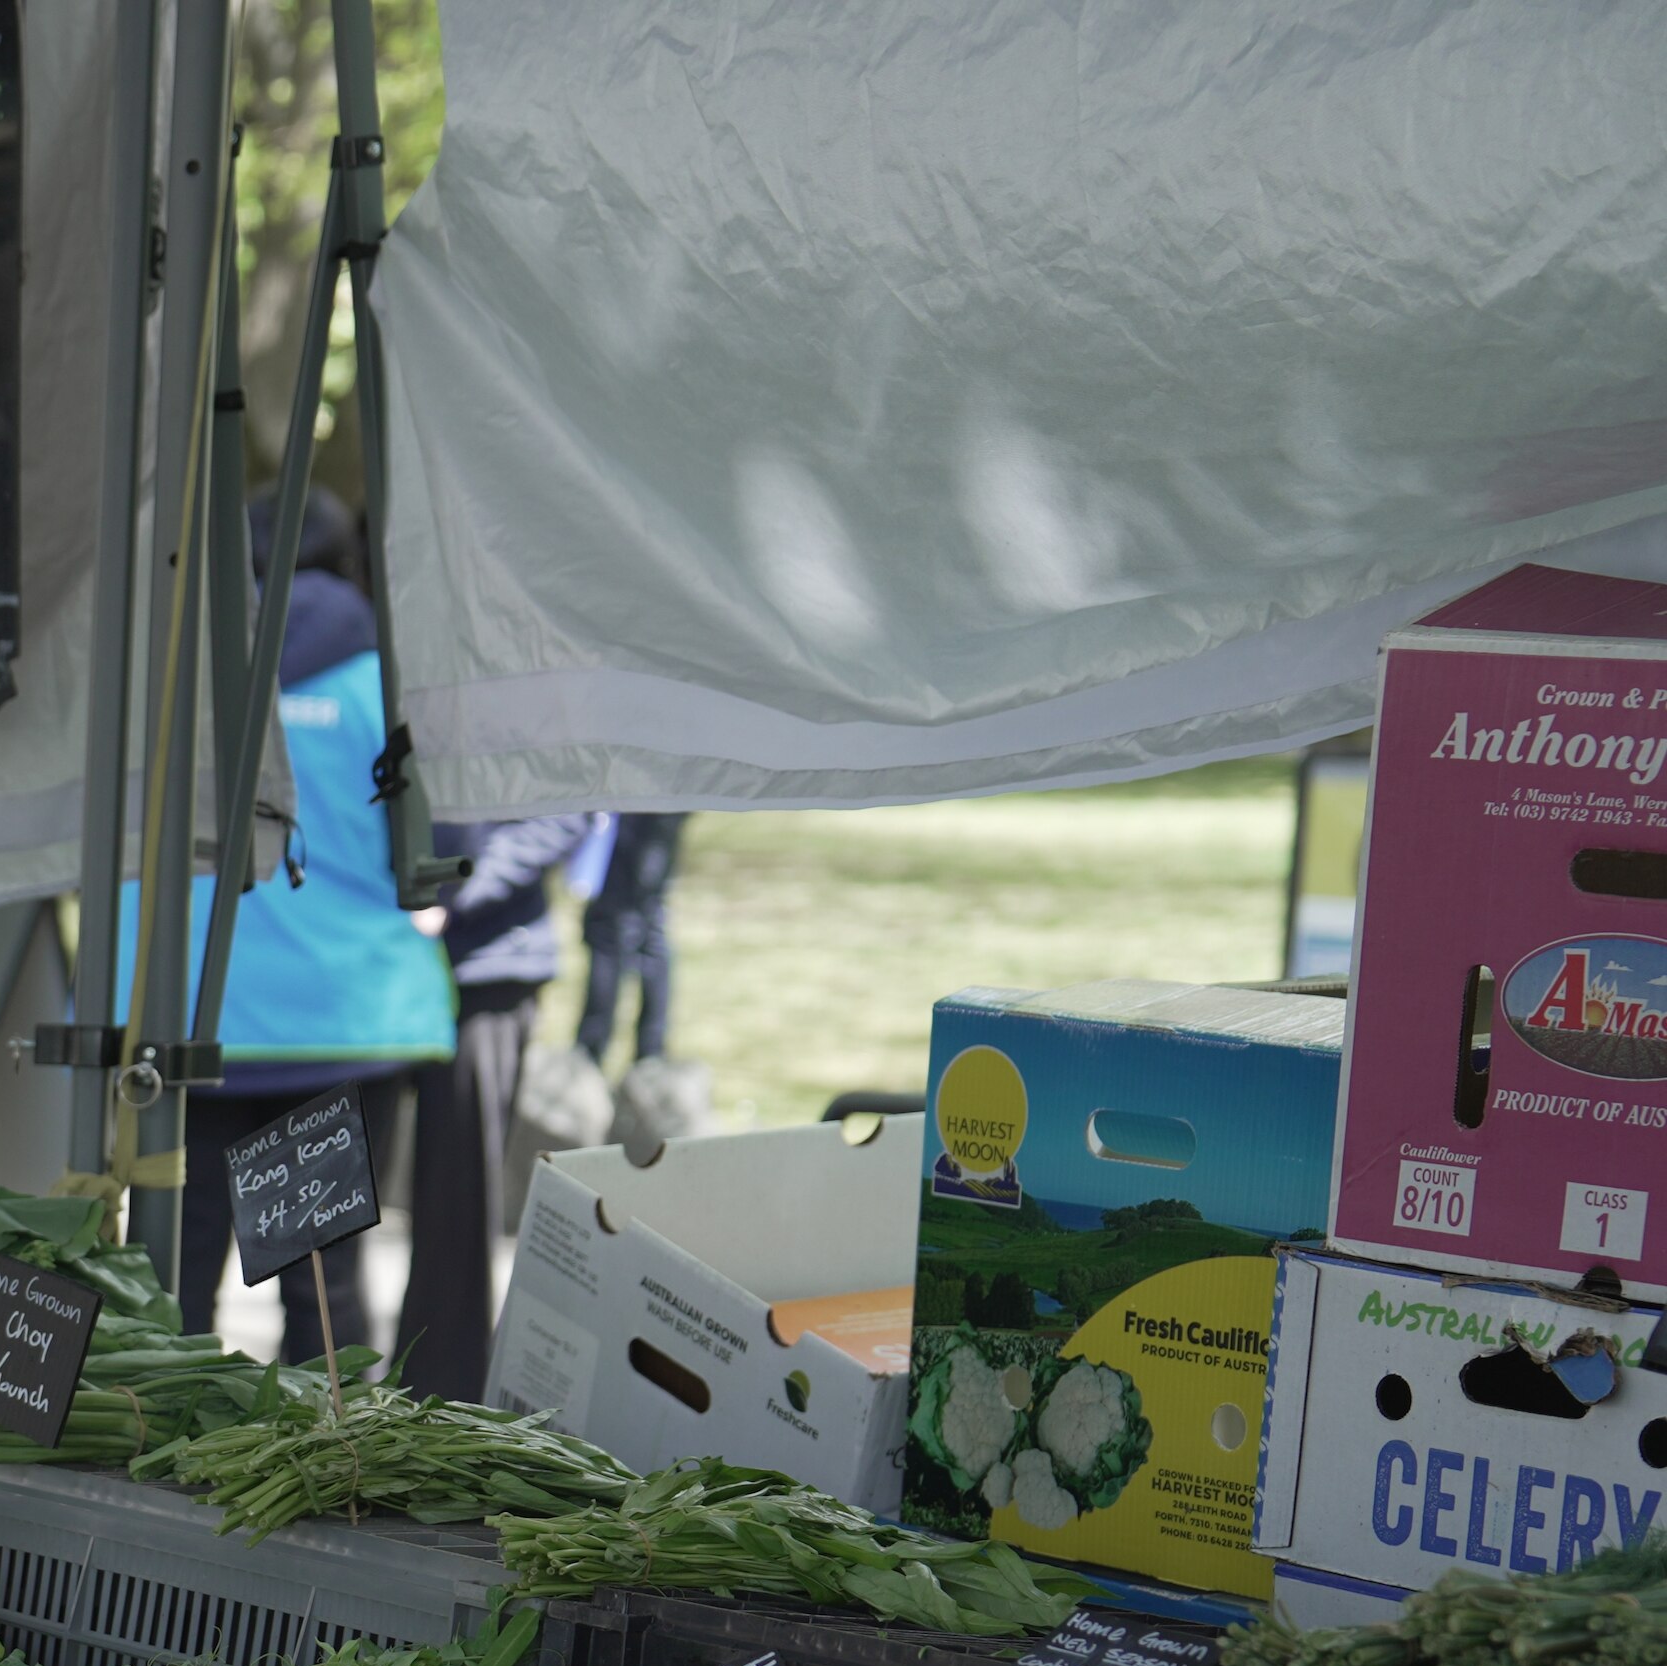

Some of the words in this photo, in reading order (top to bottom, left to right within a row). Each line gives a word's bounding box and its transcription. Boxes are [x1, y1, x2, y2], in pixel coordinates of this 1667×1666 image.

[1537, 683, 1616, 708] Grown
[1622, 687, 1644, 709] &
[1648, 689, 1667, 710] P
[1430, 711, 1667, 786] Anthony
[1483, 802, 1510, 818] Tel:
[1513, 804, 1546, 821] (03)
[1549, 806, 1589, 823] 9742
[1593, 809, 1633, 826] 1943
[1511, 788, 1521, 801] 4
[1524, 787, 1583, 807] Mason's
[1586, 792, 1627, 812] Lane,
[1526, 948, 1589, 1032] A
[1492, 1088, 1591, 1120] PRODUCT
[1592, 1100, 1624, 1123] OF
[226, 1129, 283, 1170] Home
[286, 1096, 351, 1137] Grown
[947, 1116, 1016, 1142] HARVEST
[235, 1163, 290, 1200] Kang
[297, 1127, 352, 1166] Kong
[952, 1139, 1006, 1163] MOON
[1400, 1142, 1482, 1166] Cauliflower
[1413, 1167, 1461, 1188] COUNT
[1400, 1185, 1465, 1228] 8/10
[1584, 1190, 1629, 1211] CLASS
[1595, 1212, 1610, 1249] 1
[25, 1275, 83, 1325] Grown
[640, 1275, 705, 1324] AUSTRALIAN
[704, 1316, 749, 1354] GROWN
[5, 1310, 54, 1364] Choy
[646, 1301, 675, 1327] WASH
[674, 1316, 713, 1352] BEFORE
[713, 1342, 734, 1366] USE
[1124, 1310, 1183, 1342] Fresh
[1141, 1343, 1201, 1364] PRODUCT
[1204, 1354, 1221, 1367] OF
[767, 1397, 819, 1441] Freshcare
[1152, 1477, 1221, 1502] HARVEST
[1158, 1468, 1194, 1483] GROWN
[1195, 1476, 1201, 1484] &
[1204, 1476, 1242, 1492] PACKED
[1190, 1504, 1218, 1515] LEITH
[1220, 1509, 1248, 1522] ROAD
[1372, 1439, 1663, 1577] CELERY
[1160, 1526, 1195, 1541] PHONE:
[1197, 1533, 1209, 1544] 03
[1210, 1536, 1233, 1548] 6428
[1051, 1632, 1098, 1655] NEW
[1067, 1611, 1127, 1642] Home
[1137, 1631, 1209, 1661] Grown
